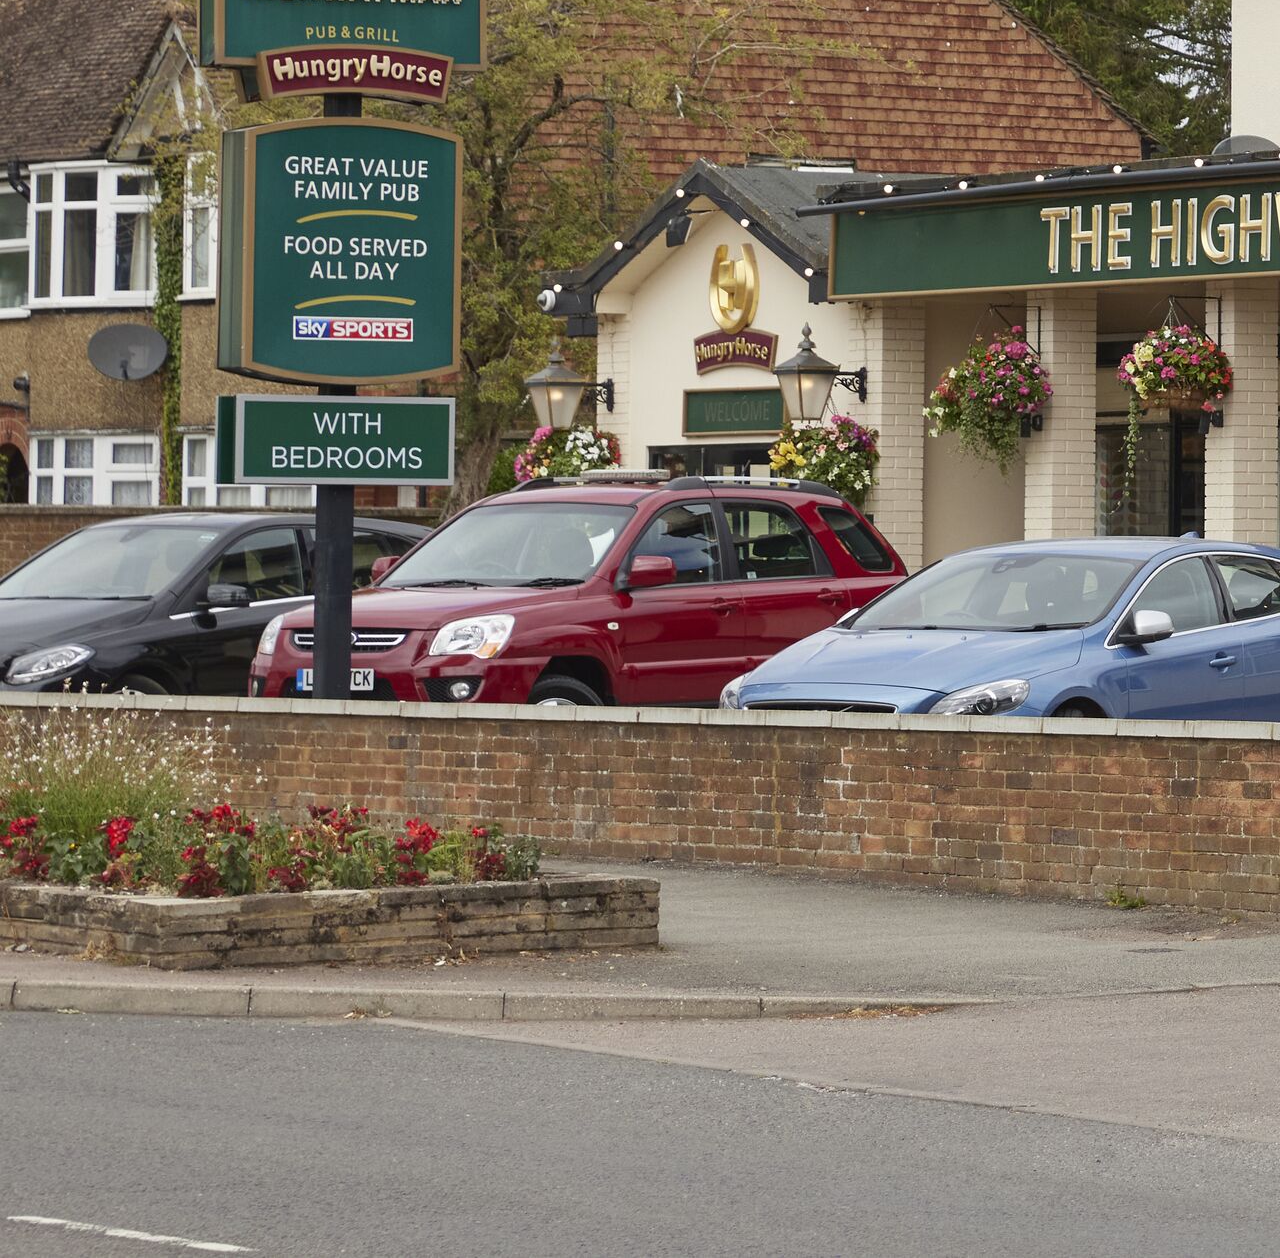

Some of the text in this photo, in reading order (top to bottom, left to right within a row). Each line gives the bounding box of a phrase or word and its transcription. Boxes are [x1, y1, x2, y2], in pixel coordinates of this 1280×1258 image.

[305, 26, 400, 43] PUB & GRILL
[284, 155, 429, 180] GREAT VALUE
[294, 180, 420, 202] FAMILY PUB
[284, 235, 428, 258] FOOD SERVED
[1040, 202, 1133, 275] THE
[309, 261, 400, 281] ALL DAY
[298, 319, 409, 339] sky SPORTS
[704, 398, 770, 423] WELCOME
[313, 412, 382, 436] WITH
[271, 446, 423, 470] BEDROOMS
